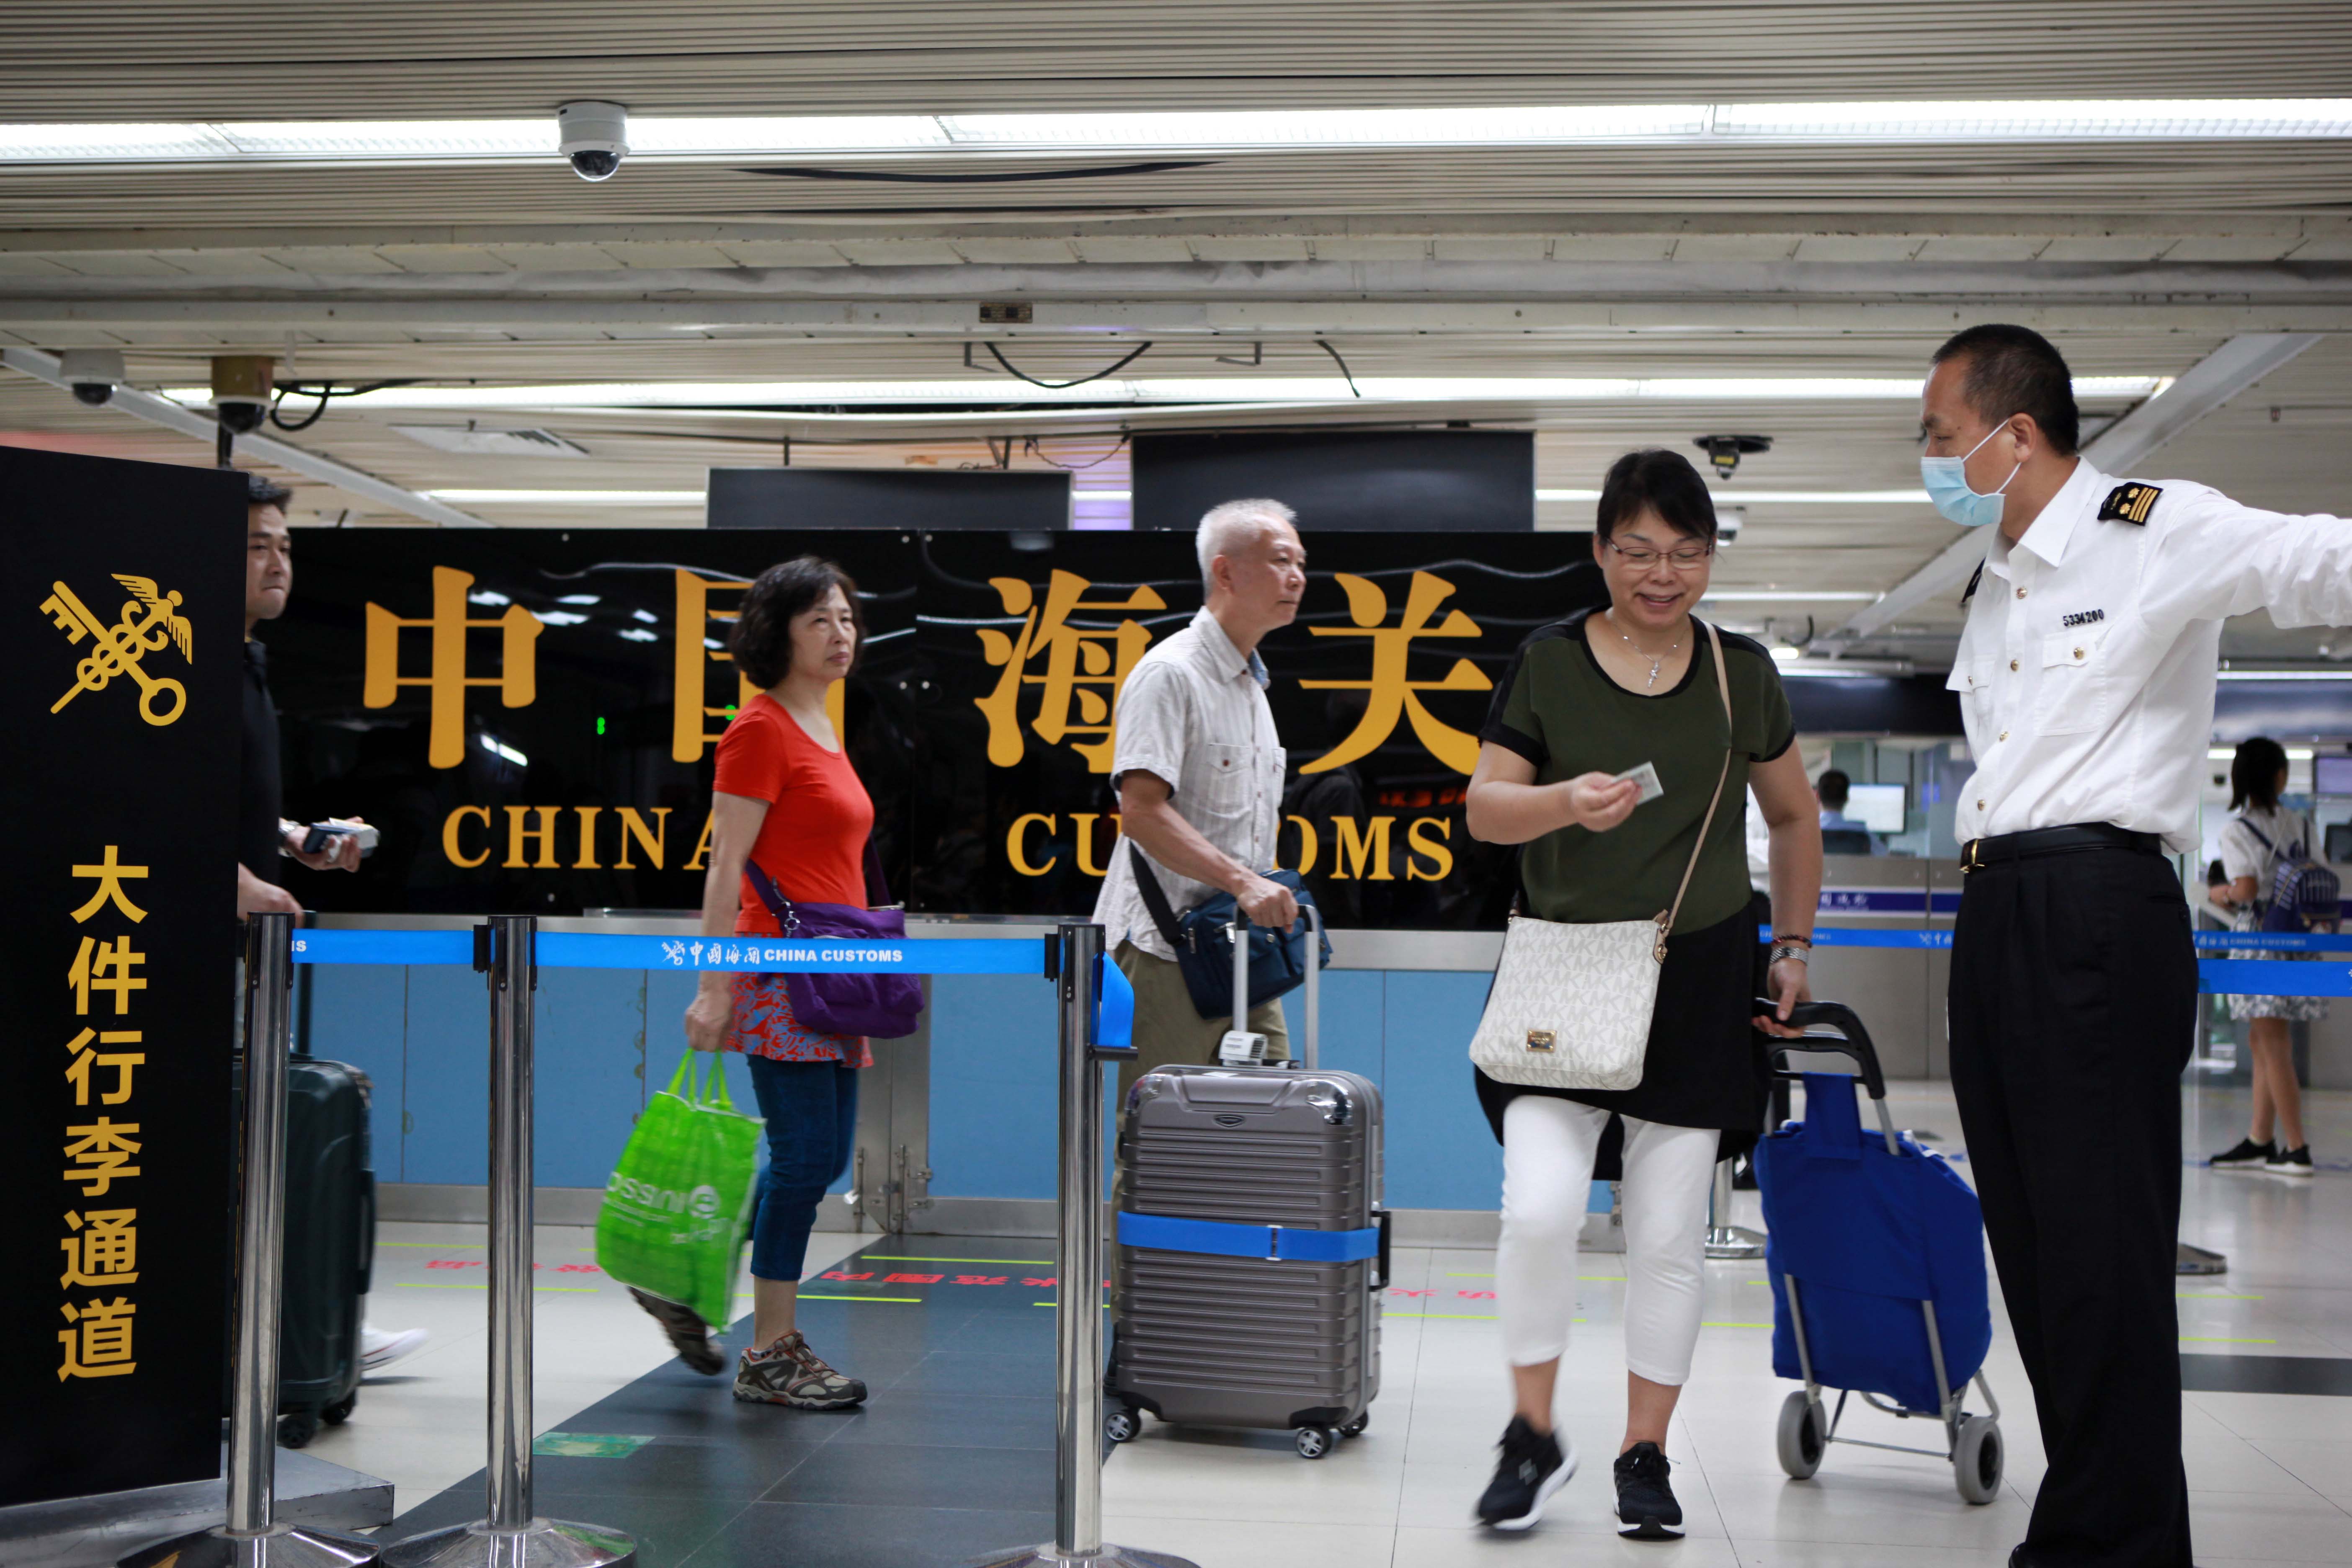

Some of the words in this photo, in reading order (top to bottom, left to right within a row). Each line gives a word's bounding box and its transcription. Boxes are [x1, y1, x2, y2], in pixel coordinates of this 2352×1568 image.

[1007, 814, 1453, 881] CUOMS
[764, 949, 818, 962] CHINA
[821, 950, 903, 962] CUSTOMS
[57, 846, 149, 1382] 大件行李通道
